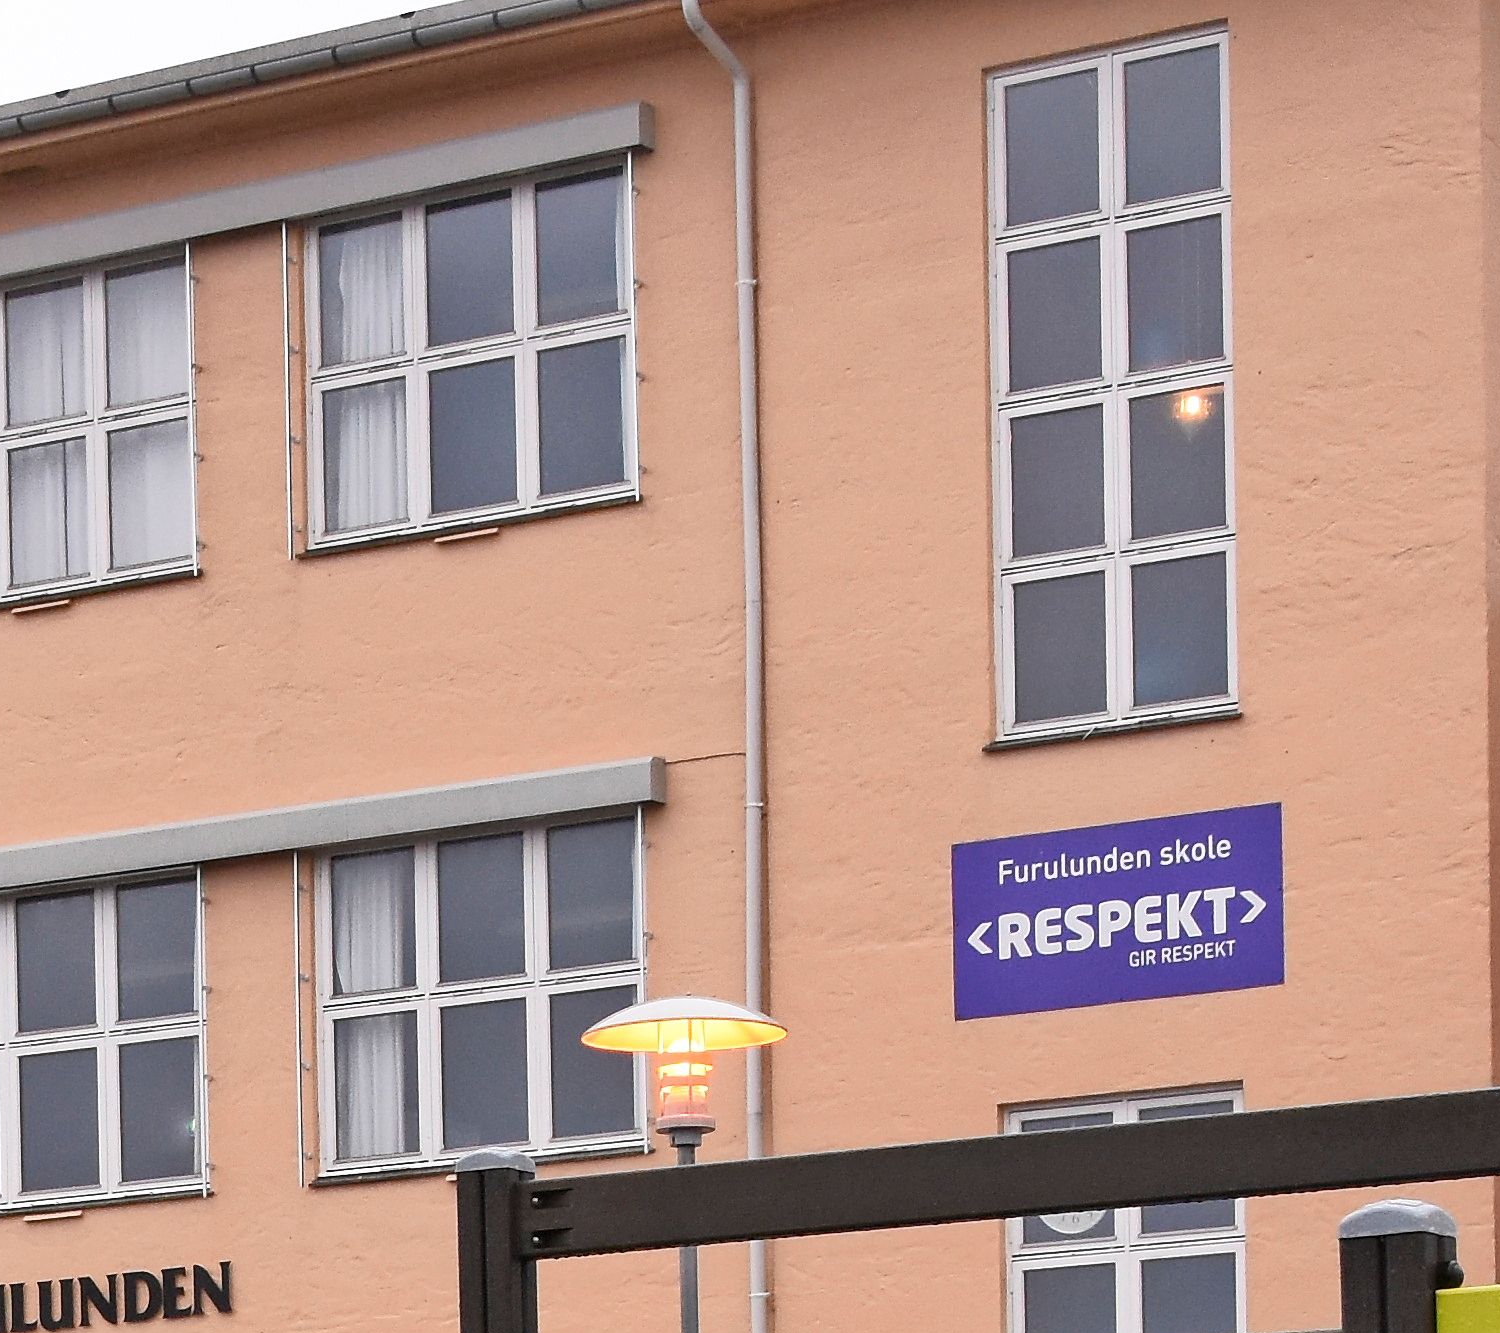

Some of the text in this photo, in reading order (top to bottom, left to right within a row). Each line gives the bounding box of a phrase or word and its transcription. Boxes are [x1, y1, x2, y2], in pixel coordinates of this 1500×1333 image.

[998, 834, 1232, 885] Furulunden skole
[1129, 939, 1236, 968] GIR RESPEKT
